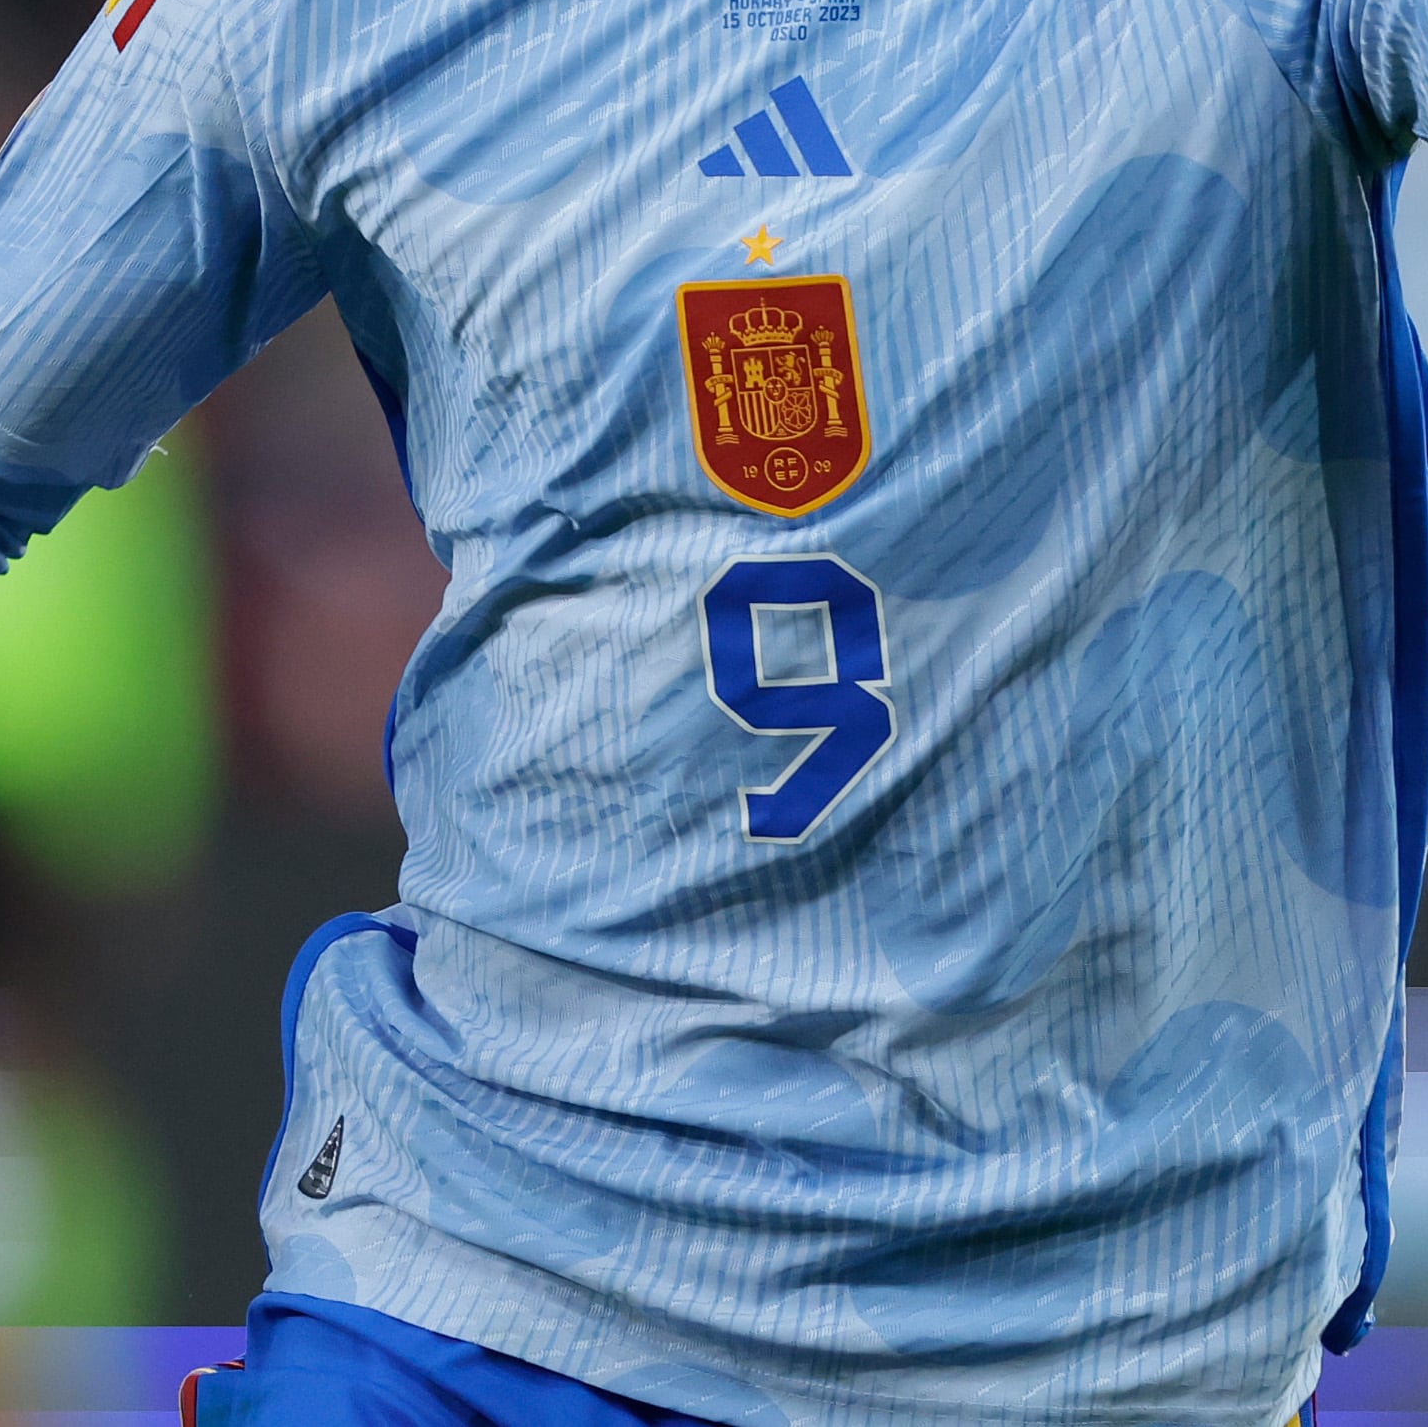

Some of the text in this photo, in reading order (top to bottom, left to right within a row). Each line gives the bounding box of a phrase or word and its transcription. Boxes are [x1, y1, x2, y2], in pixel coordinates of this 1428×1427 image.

[722, 5, 861, 29] 15 OCTOBER 2023
[770, 25, 808, 42] OSLO
[742, 465, 759, 479] 19
[813, 459, 832, 473] 09
[696, 552, 898, 845] 9
